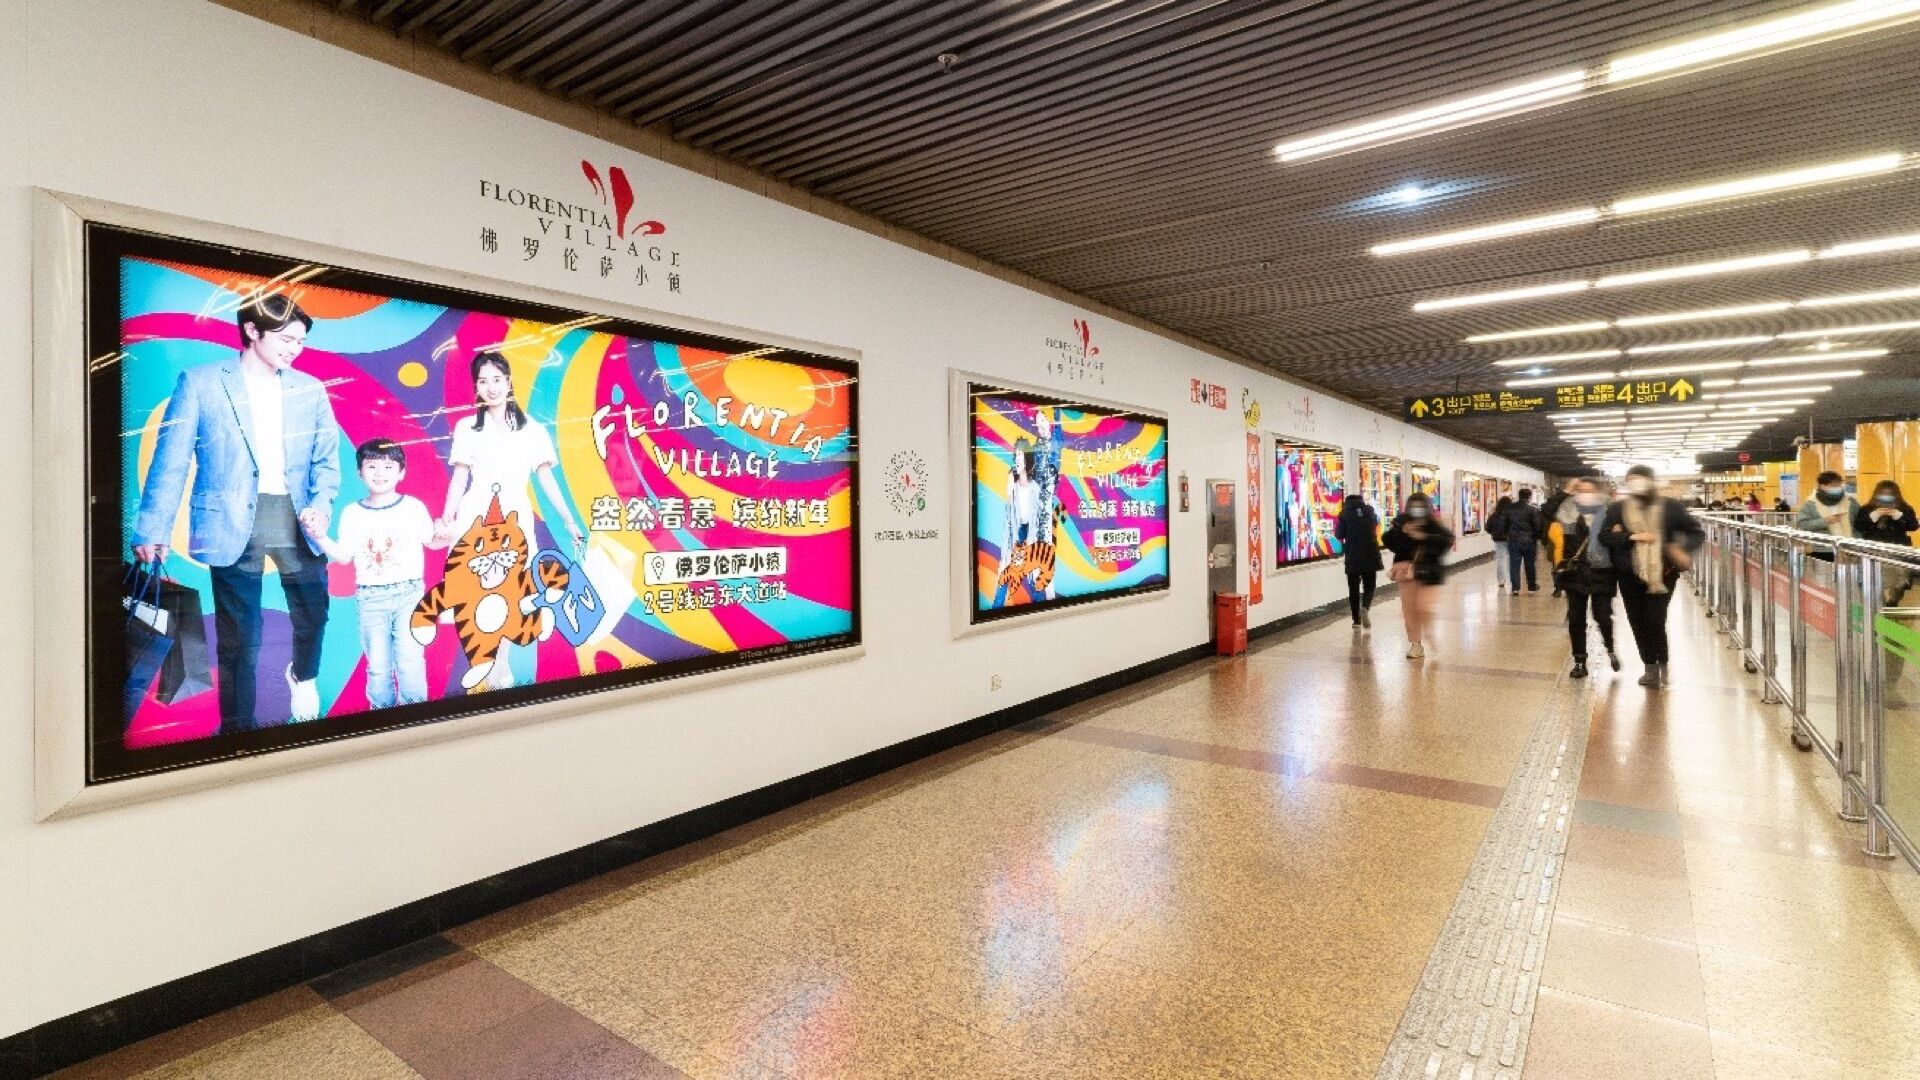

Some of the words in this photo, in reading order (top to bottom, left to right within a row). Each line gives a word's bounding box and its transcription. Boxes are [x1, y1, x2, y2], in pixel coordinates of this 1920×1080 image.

[479, 179, 612, 231] FLORENTIA
[538, 217, 680, 267] VILLAGE
[479, 226, 681, 294] 佛罗伦萨小镇
[1446, 395, 1471, 408] 出口
[1616, 382, 1634, 404] 4
[1637, 381, 1666, 395] 出口
[1637, 394, 1660, 403] EXIT
[1432, 397, 1445, 417] 3
[1448, 407, 1466, 415] EXIT
[653, 444, 780, 479] VILLAGE
[590, 495, 717, 532] 盎然春意
[731, 497, 830, 530] 缤纷新年
[675, 551, 781, 578] 佛罗伦萨小镇
[643, 581, 787, 615] 2号线远东大道站
